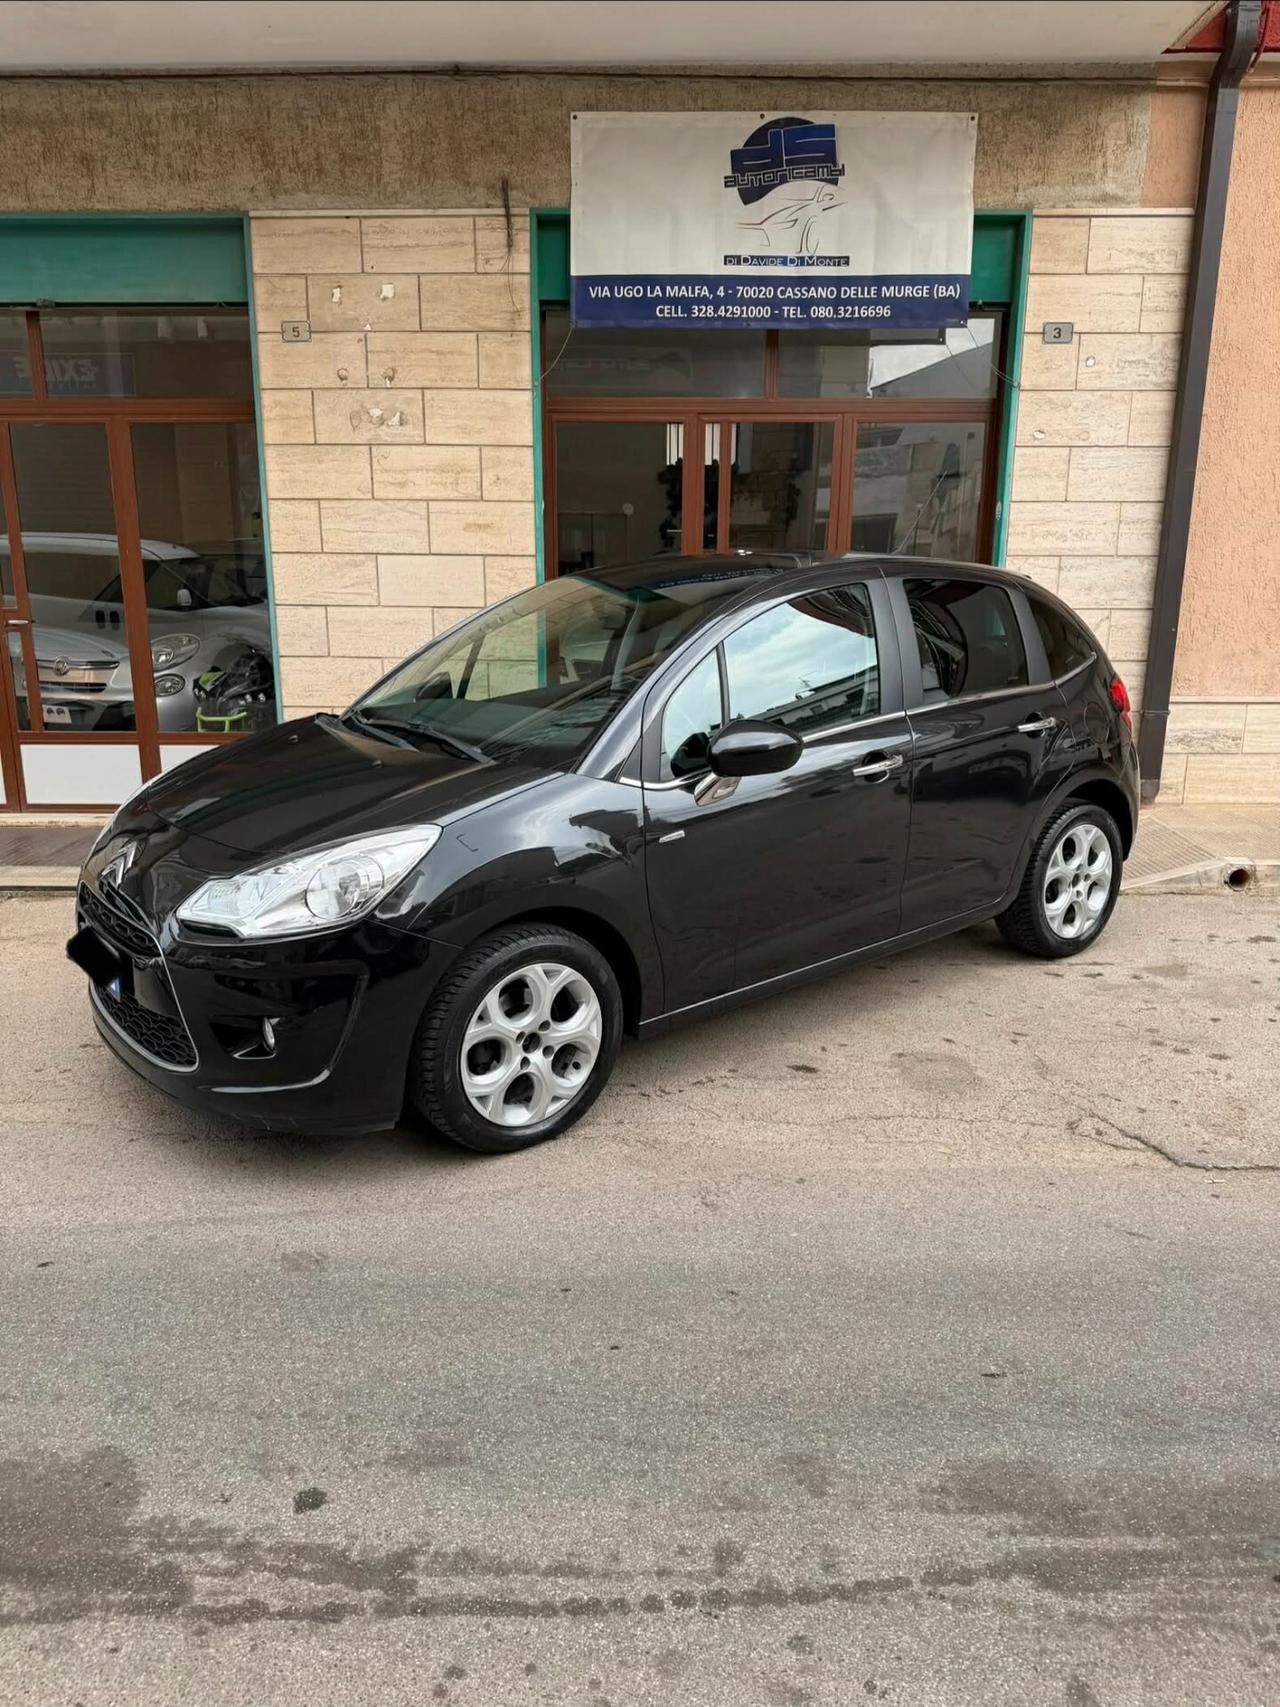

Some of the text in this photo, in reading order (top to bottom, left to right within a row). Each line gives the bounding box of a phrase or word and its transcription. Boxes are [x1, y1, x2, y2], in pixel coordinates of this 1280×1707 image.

[589, 286, 611, 298] VIA
[614, 286, 643, 298] UGO
[647, 286, 662, 297] LA
[666, 286, 713, 299] MALFA,
[716, 287, 725, 297] 4
[736, 286, 774, 298] 70020
[777, 286, 837, 299] CASSANO
[841, 286, 878, 298] DELLE
[881, 285, 930, 297] MURGE
[933, 284, 961, 299] (BA)
[656, 305, 688, 317] CELL.
[691, 305, 771, 318] 328.4291000
[782, 306, 807, 318] TEL.
[810, 305, 891, 318] 080.3216696
[292, 326, 300, 337] 5
[1053, 327, 1062, 338] 3
